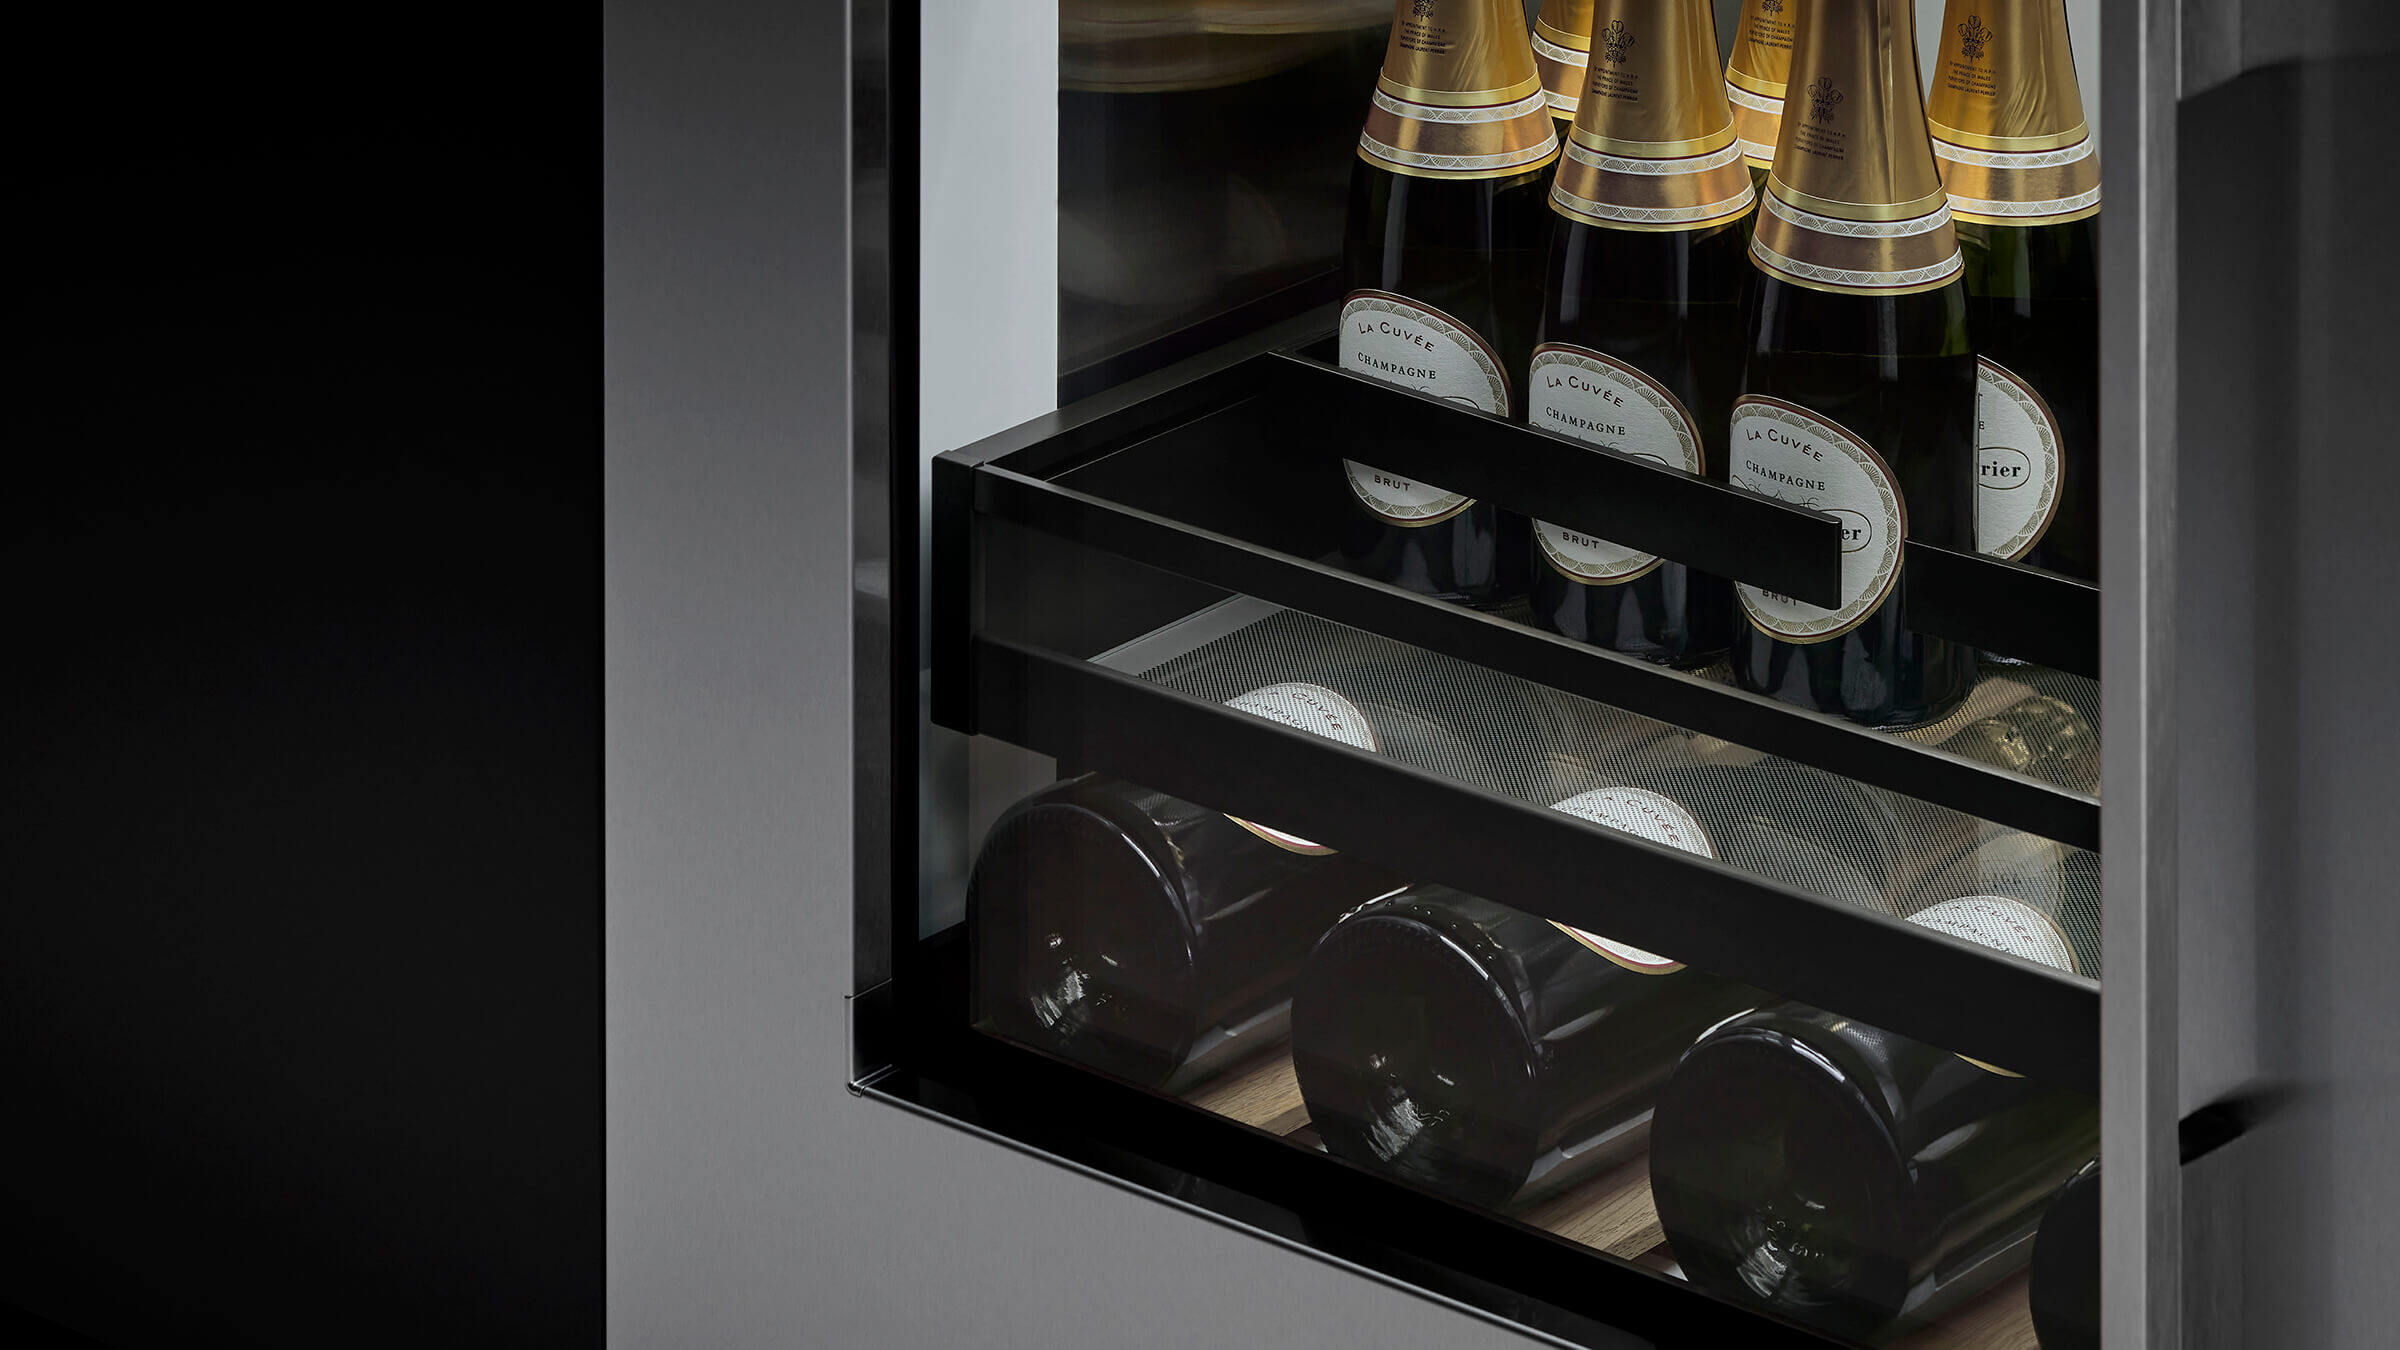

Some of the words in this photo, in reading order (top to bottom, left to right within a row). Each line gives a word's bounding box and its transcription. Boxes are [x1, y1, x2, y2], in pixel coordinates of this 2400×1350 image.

[1357, 321, 1374, 335] LA
[1379, 321, 1435, 353] CUVÉE
[1357, 352, 1437, 380] CHAMPAGNE
[1546, 375, 1562, 389] LA
[1568, 375, 1624, 408] CUVÉE
[1545, 406, 1627, 436] CHAMPAGNE
[1745, 428, 1762, 442] LA
[1767, 428, 1824, 463] CUVÉE
[1374, 474, 1411, 492] BRUT
[1745, 459, 1826, 491] CHAMPAGNE
[1562, 531, 1600, 549] BRUT
